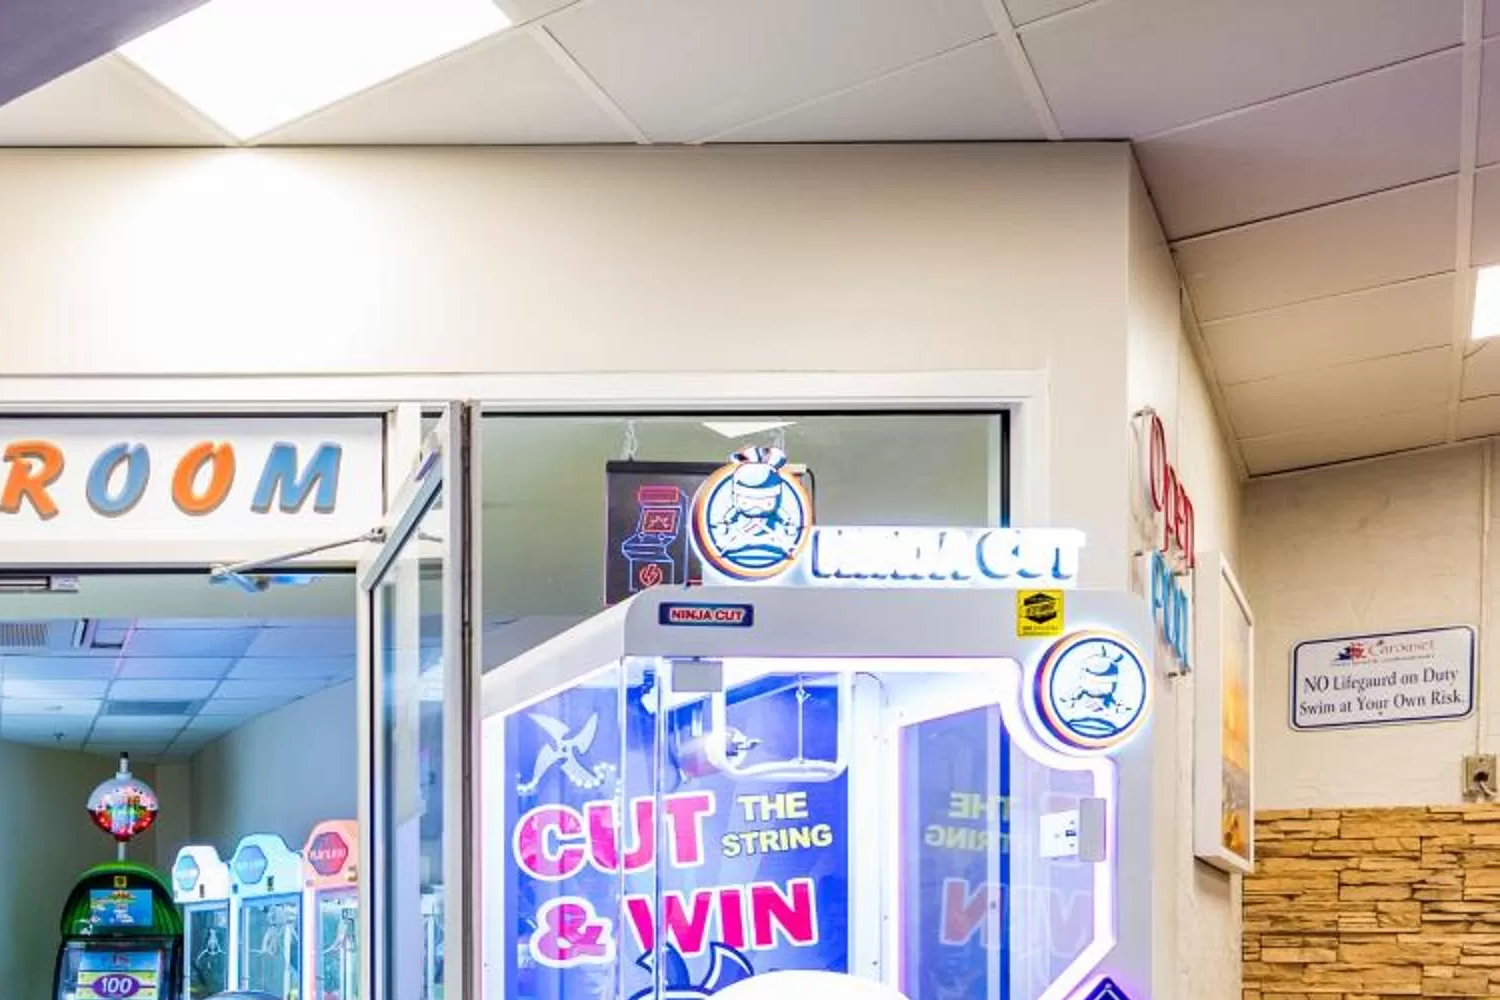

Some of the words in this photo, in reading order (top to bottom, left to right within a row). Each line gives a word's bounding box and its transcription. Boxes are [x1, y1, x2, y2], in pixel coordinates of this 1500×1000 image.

[671, 609, 712, 621] NINJA
[715, 609, 742, 621] CUT
[1303, 675, 1329, 693] NO
[1401, 673, 1419, 685] on
[1423, 666, 1459, 687] Duty
[1299, 700, 1335, 716] Swim
[1340, 701, 1352, 713] at
[1356, 695, 1389, 711] Your
[1393, 693, 1426, 708] Own
[738, 791, 809, 823] THE
[514, 791, 714, 881] CUT
[722, 824, 834, 858] STRING
[530, 897, 616, 968] &
[624, 878, 818, 957] WIN
[101, 976, 133, 994] 100
